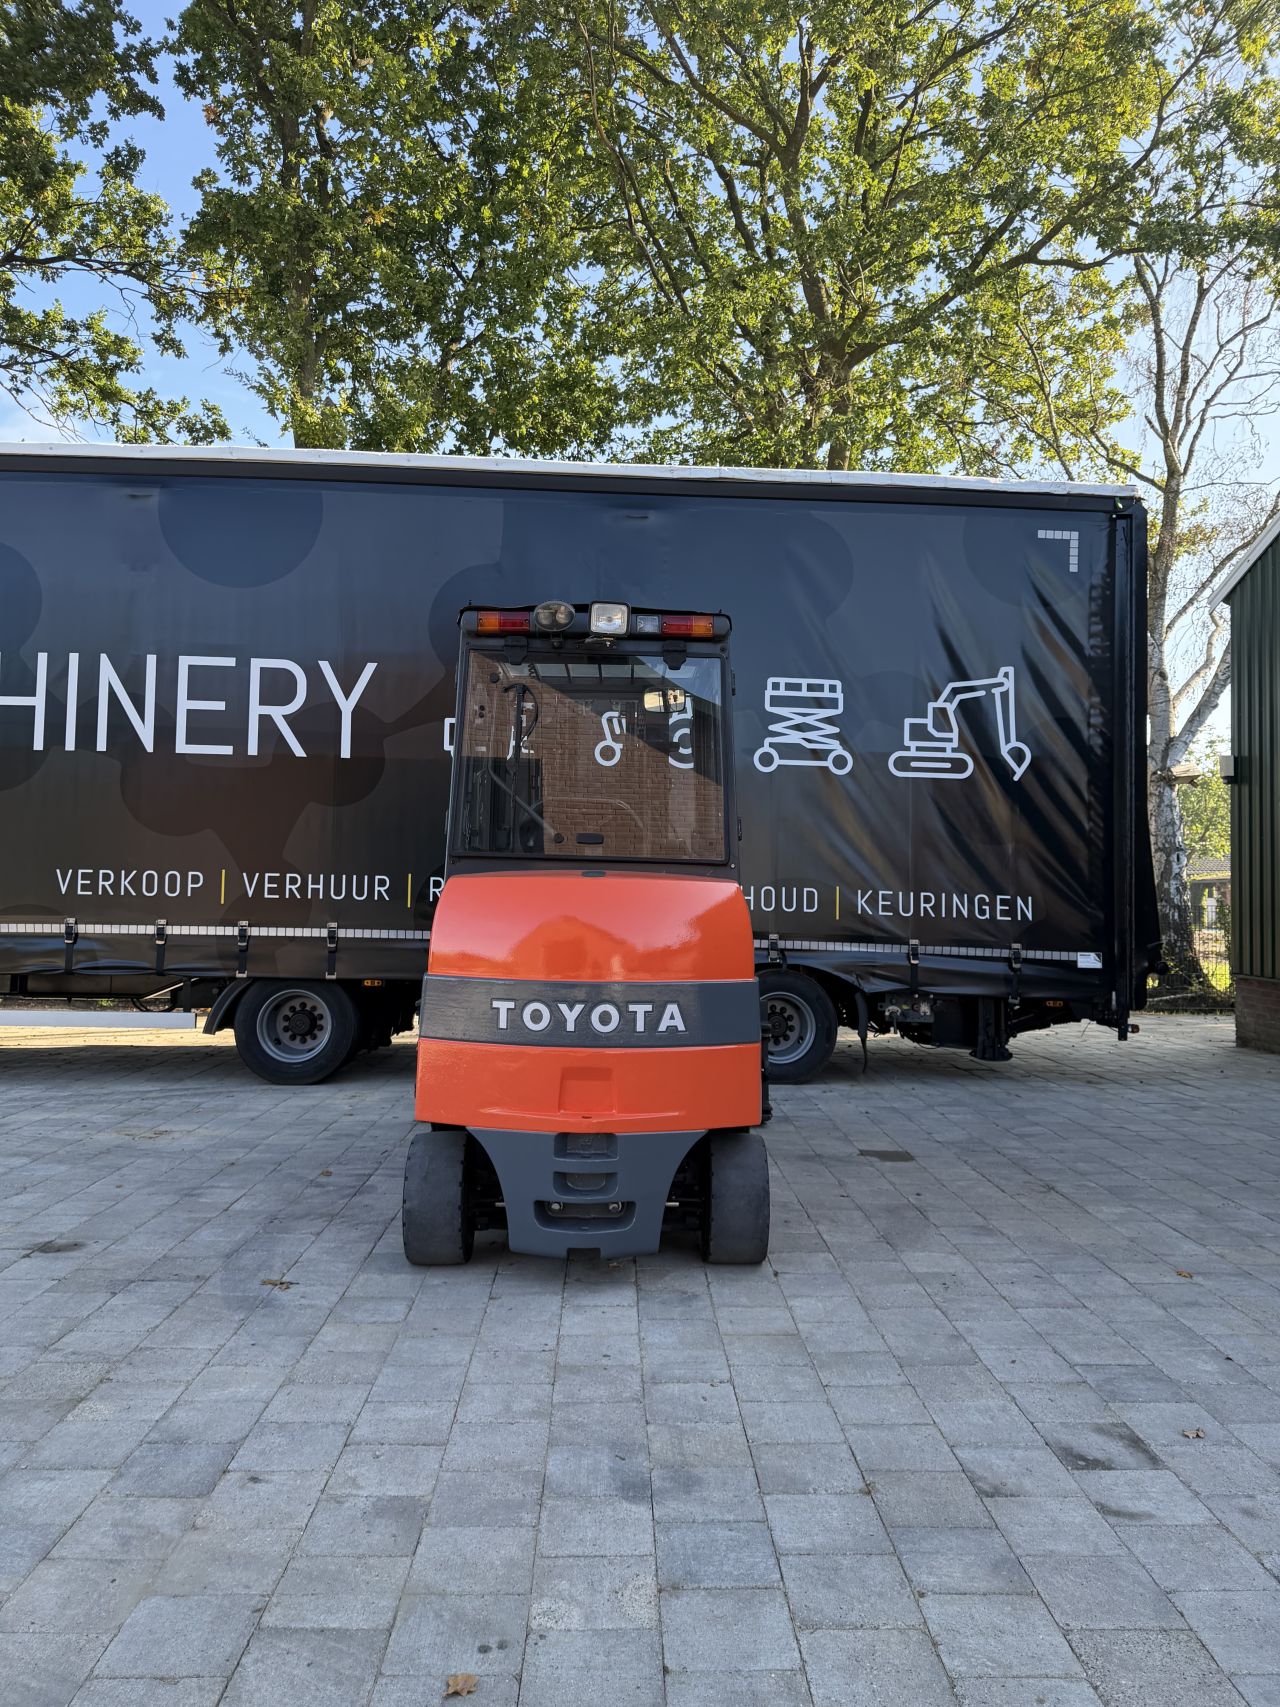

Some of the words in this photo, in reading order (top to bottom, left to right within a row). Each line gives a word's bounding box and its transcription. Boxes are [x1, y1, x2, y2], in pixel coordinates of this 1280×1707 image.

[56, 868, 204, 898] VERKOOP
[243, 872, 390, 902] VERHUUR
[857, 889, 1034, 922] KEURINGEN
[491, 999, 686, 1033] TOYOTA
